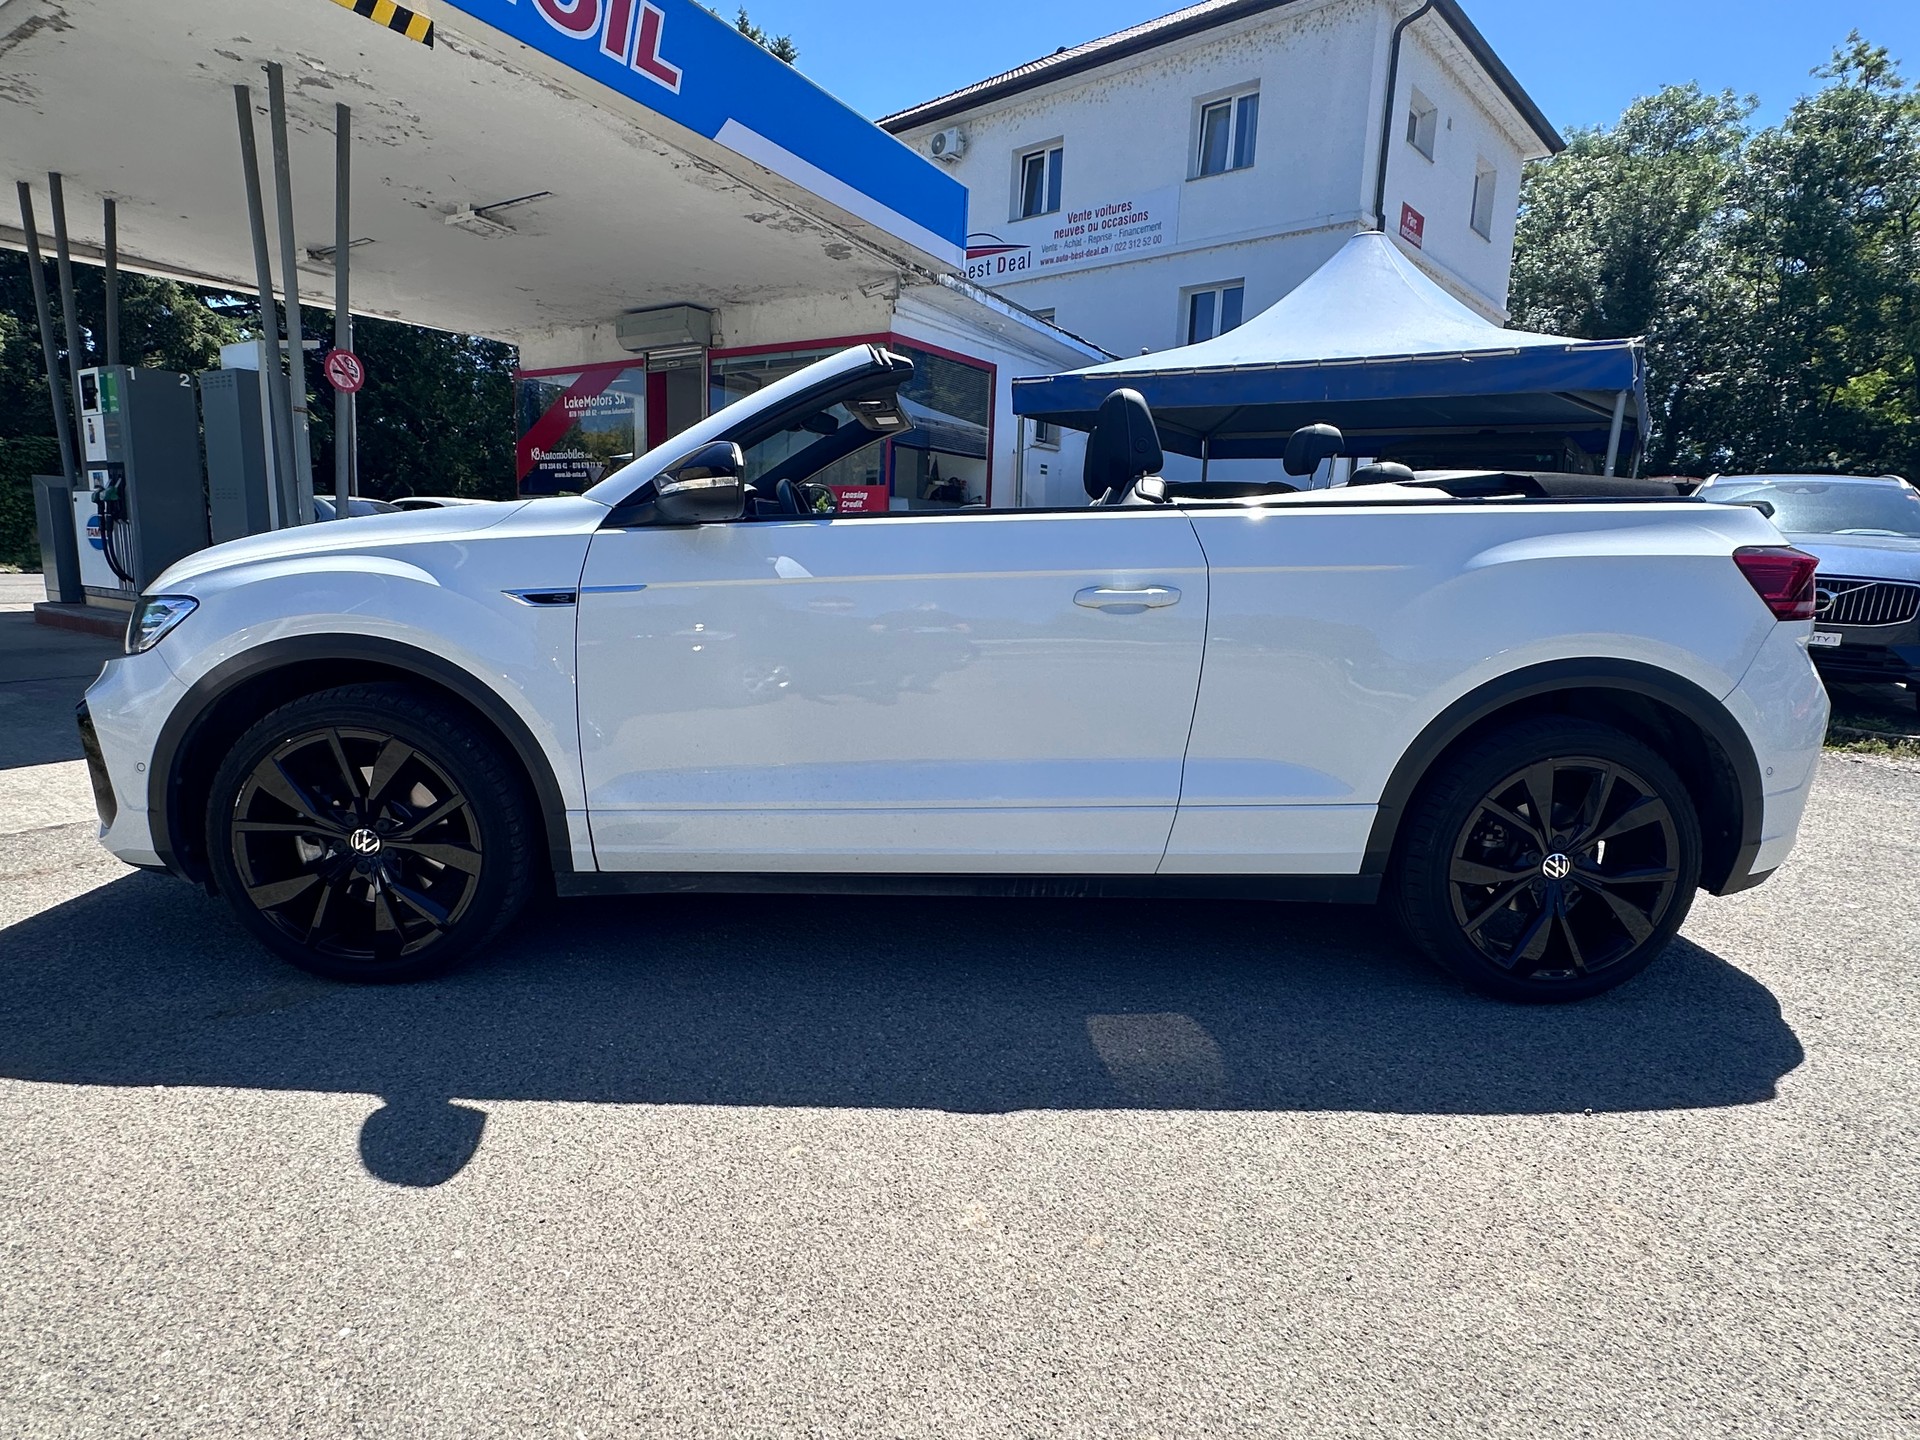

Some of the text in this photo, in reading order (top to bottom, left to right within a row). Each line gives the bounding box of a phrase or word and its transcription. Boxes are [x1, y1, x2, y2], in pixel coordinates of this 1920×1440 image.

[505, 0, 683, 95] OIL
[1053, 211, 1149, 240] neuves ou occasions
[1067, 201, 1133, 225] Vente voitures
[1040, 245, 1109, 266] www.auto-best-deal.ch
[1114, 241, 1127, 252] 022
[1128, 238, 1142, 250] 312
[1152, 234, 1163, 245] 00
[1041, 243, 1058, 254] Vente
[1064, 238, 1082, 249] Achat
[1088, 233, 1113, 245] Reprise
[1118, 221, 1162, 238] Financement
[959, 250, 1032, 279] est Deal
[126, 366, 191, 388] 1 2
[564, 393, 625, 409] LakeMotors SA
